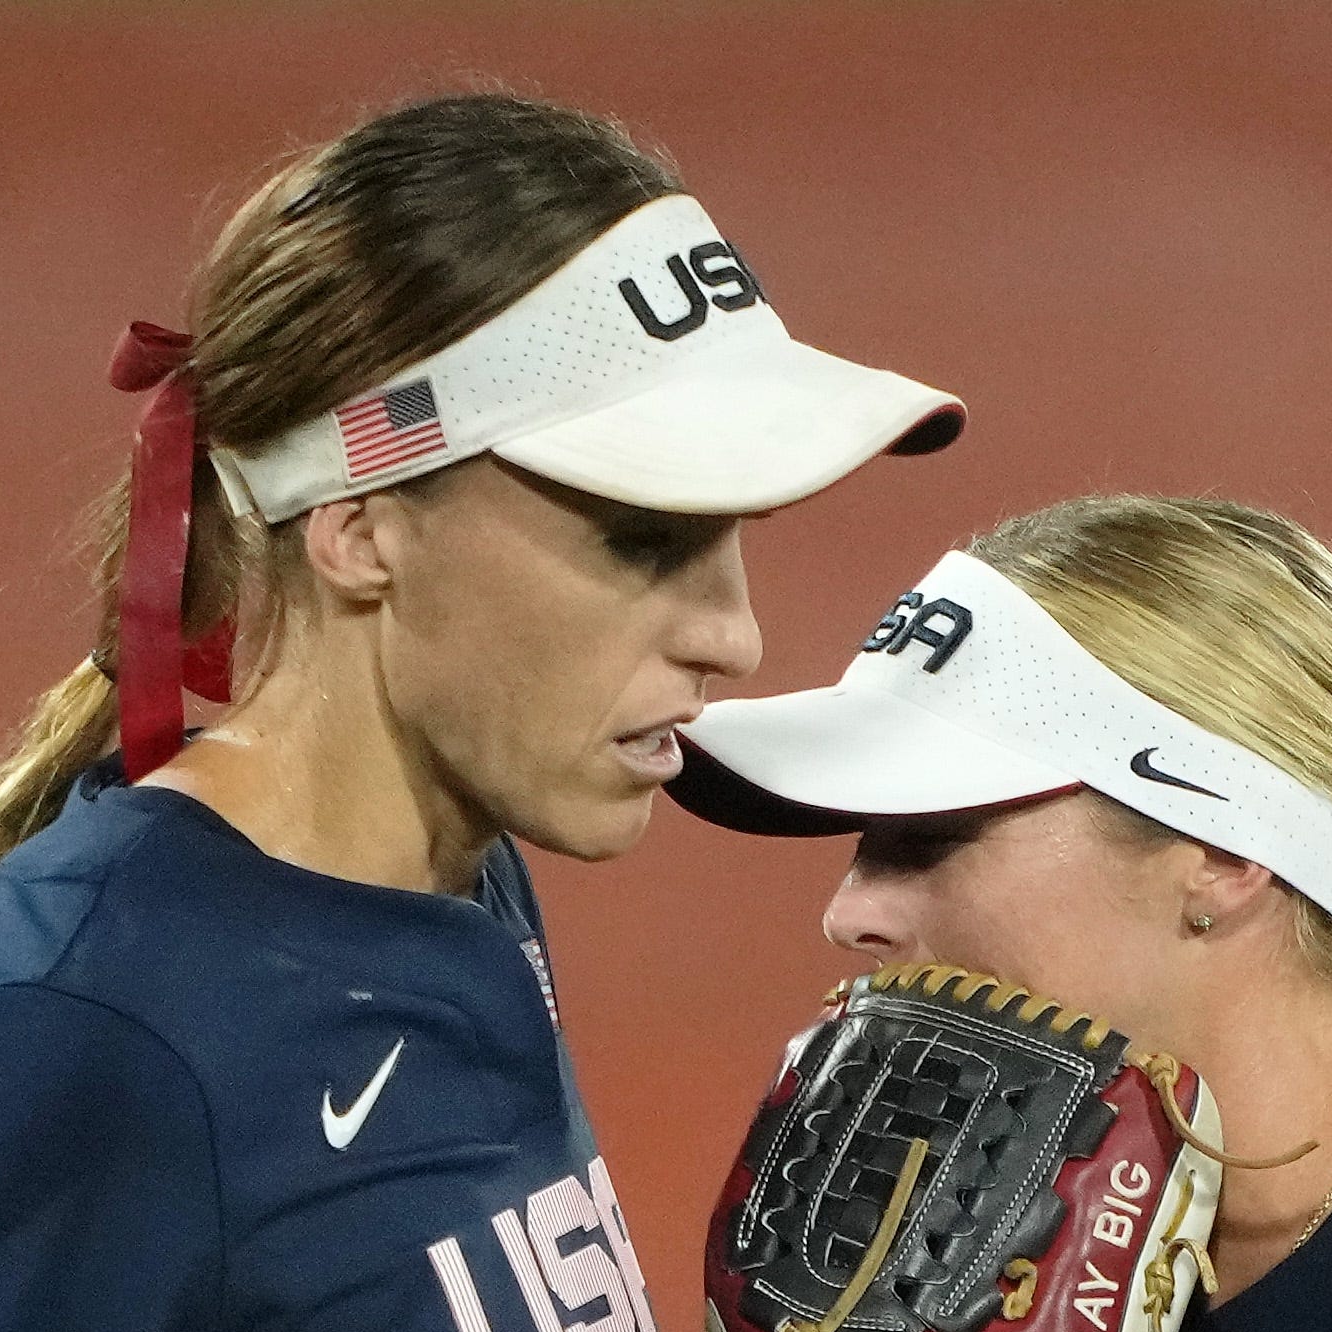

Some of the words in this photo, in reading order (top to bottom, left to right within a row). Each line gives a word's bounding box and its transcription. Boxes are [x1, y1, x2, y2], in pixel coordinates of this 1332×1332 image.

[618, 240, 769, 342] US
[861, 590, 973, 674] SA
[1092, 1159, 1152, 1249] BIG
